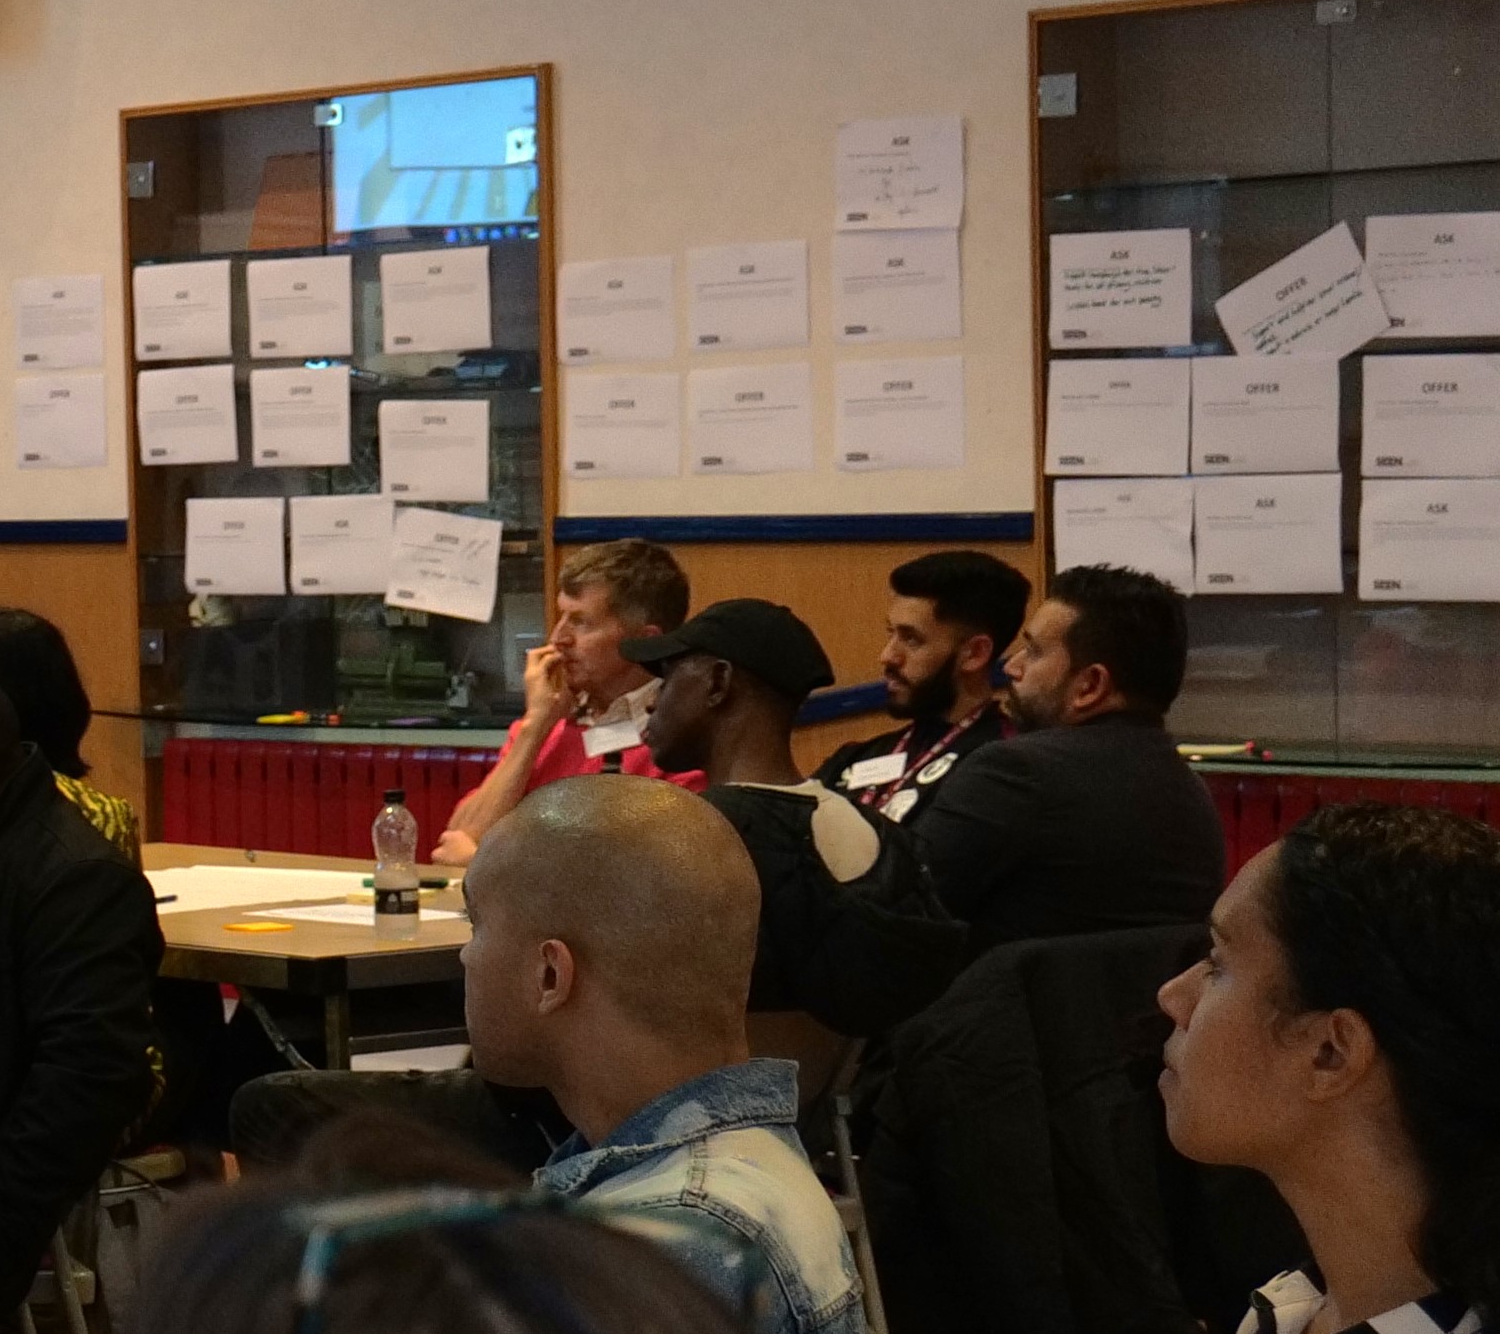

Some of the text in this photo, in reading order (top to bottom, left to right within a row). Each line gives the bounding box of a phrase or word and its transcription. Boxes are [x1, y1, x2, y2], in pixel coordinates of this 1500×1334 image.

[1434, 232, 1455, 246] ASK
[1275, 277, 1308, 302] OFFER
[1245, 382, 1280, 394] OFFER
[1421, 381, 1458, 395] OFFER
[1255, 498, 1278, 509] ASK
[1427, 503, 1450, 514] ASK
